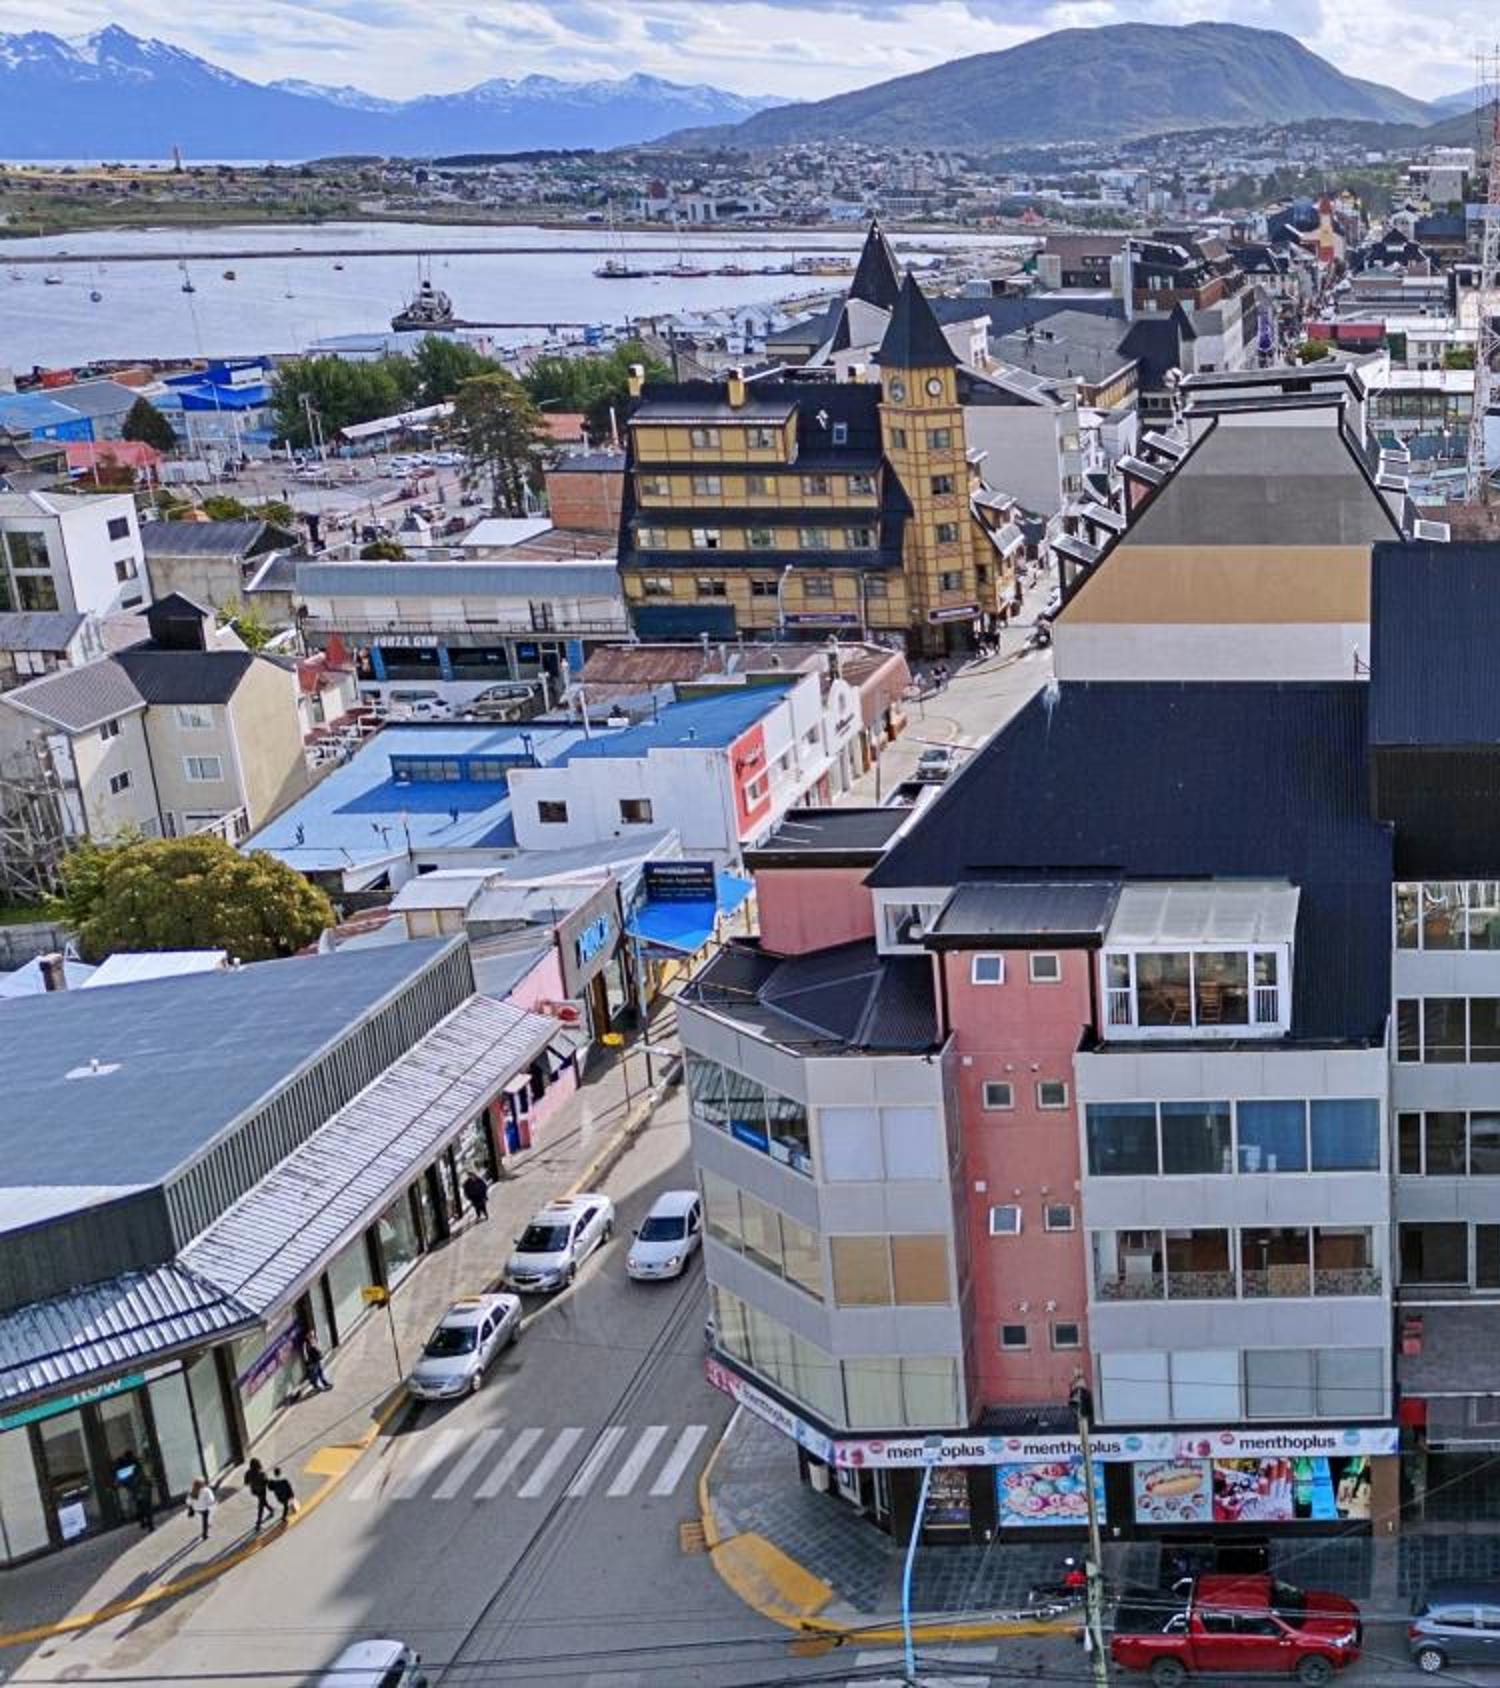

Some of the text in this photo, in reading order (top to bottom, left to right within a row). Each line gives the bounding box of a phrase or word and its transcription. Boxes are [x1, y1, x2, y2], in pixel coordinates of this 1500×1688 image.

[413, 635, 438, 647] GYM
[1239, 1436, 1337, 1451] menthoplus
[887, 1443, 986, 1460] menoplus
